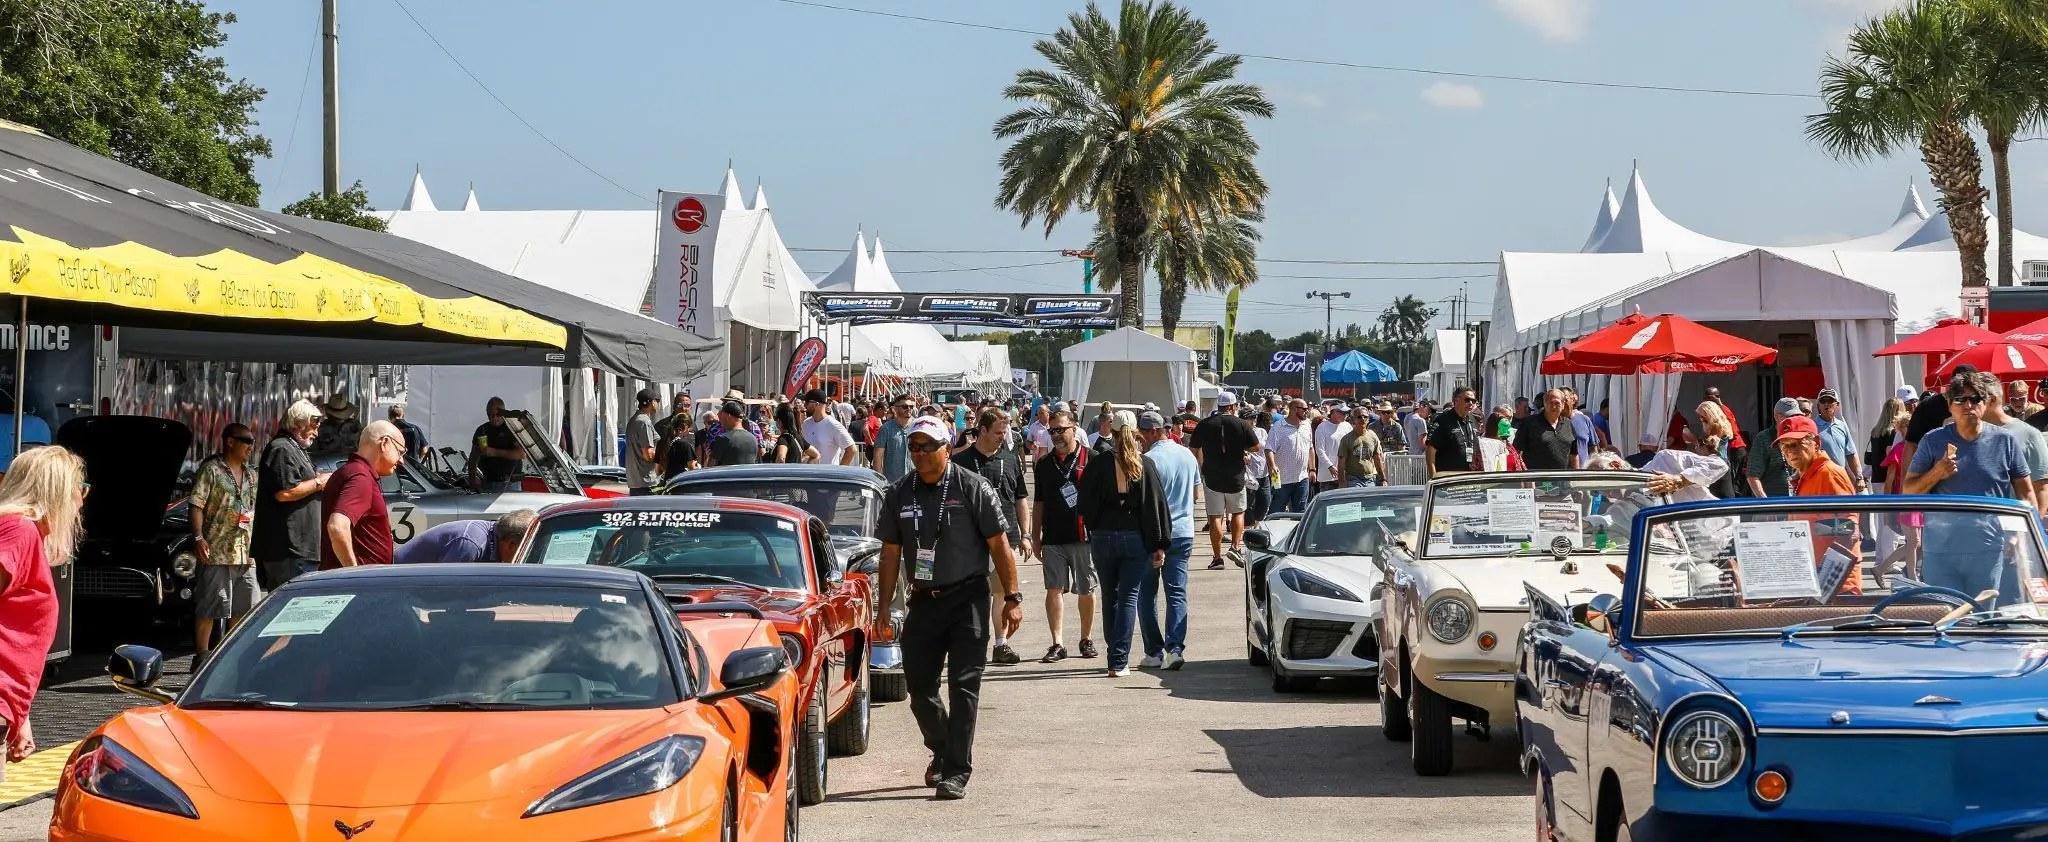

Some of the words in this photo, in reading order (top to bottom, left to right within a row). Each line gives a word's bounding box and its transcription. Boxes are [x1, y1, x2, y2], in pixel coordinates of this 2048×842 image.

[58, 257, 100, 291] Reflect
[1035, 301, 1102, 309] BluePrint
[0, 323, 70, 350] mnce
[1252, 388, 1279, 396] FORD
[602, 512, 633, 523] 302
[637, 511, 721, 523] STROKER
[392, 507, 415, 545] 3
[665, 520, 711, 528] Injected
[1788, 531, 1807, 539] 764
